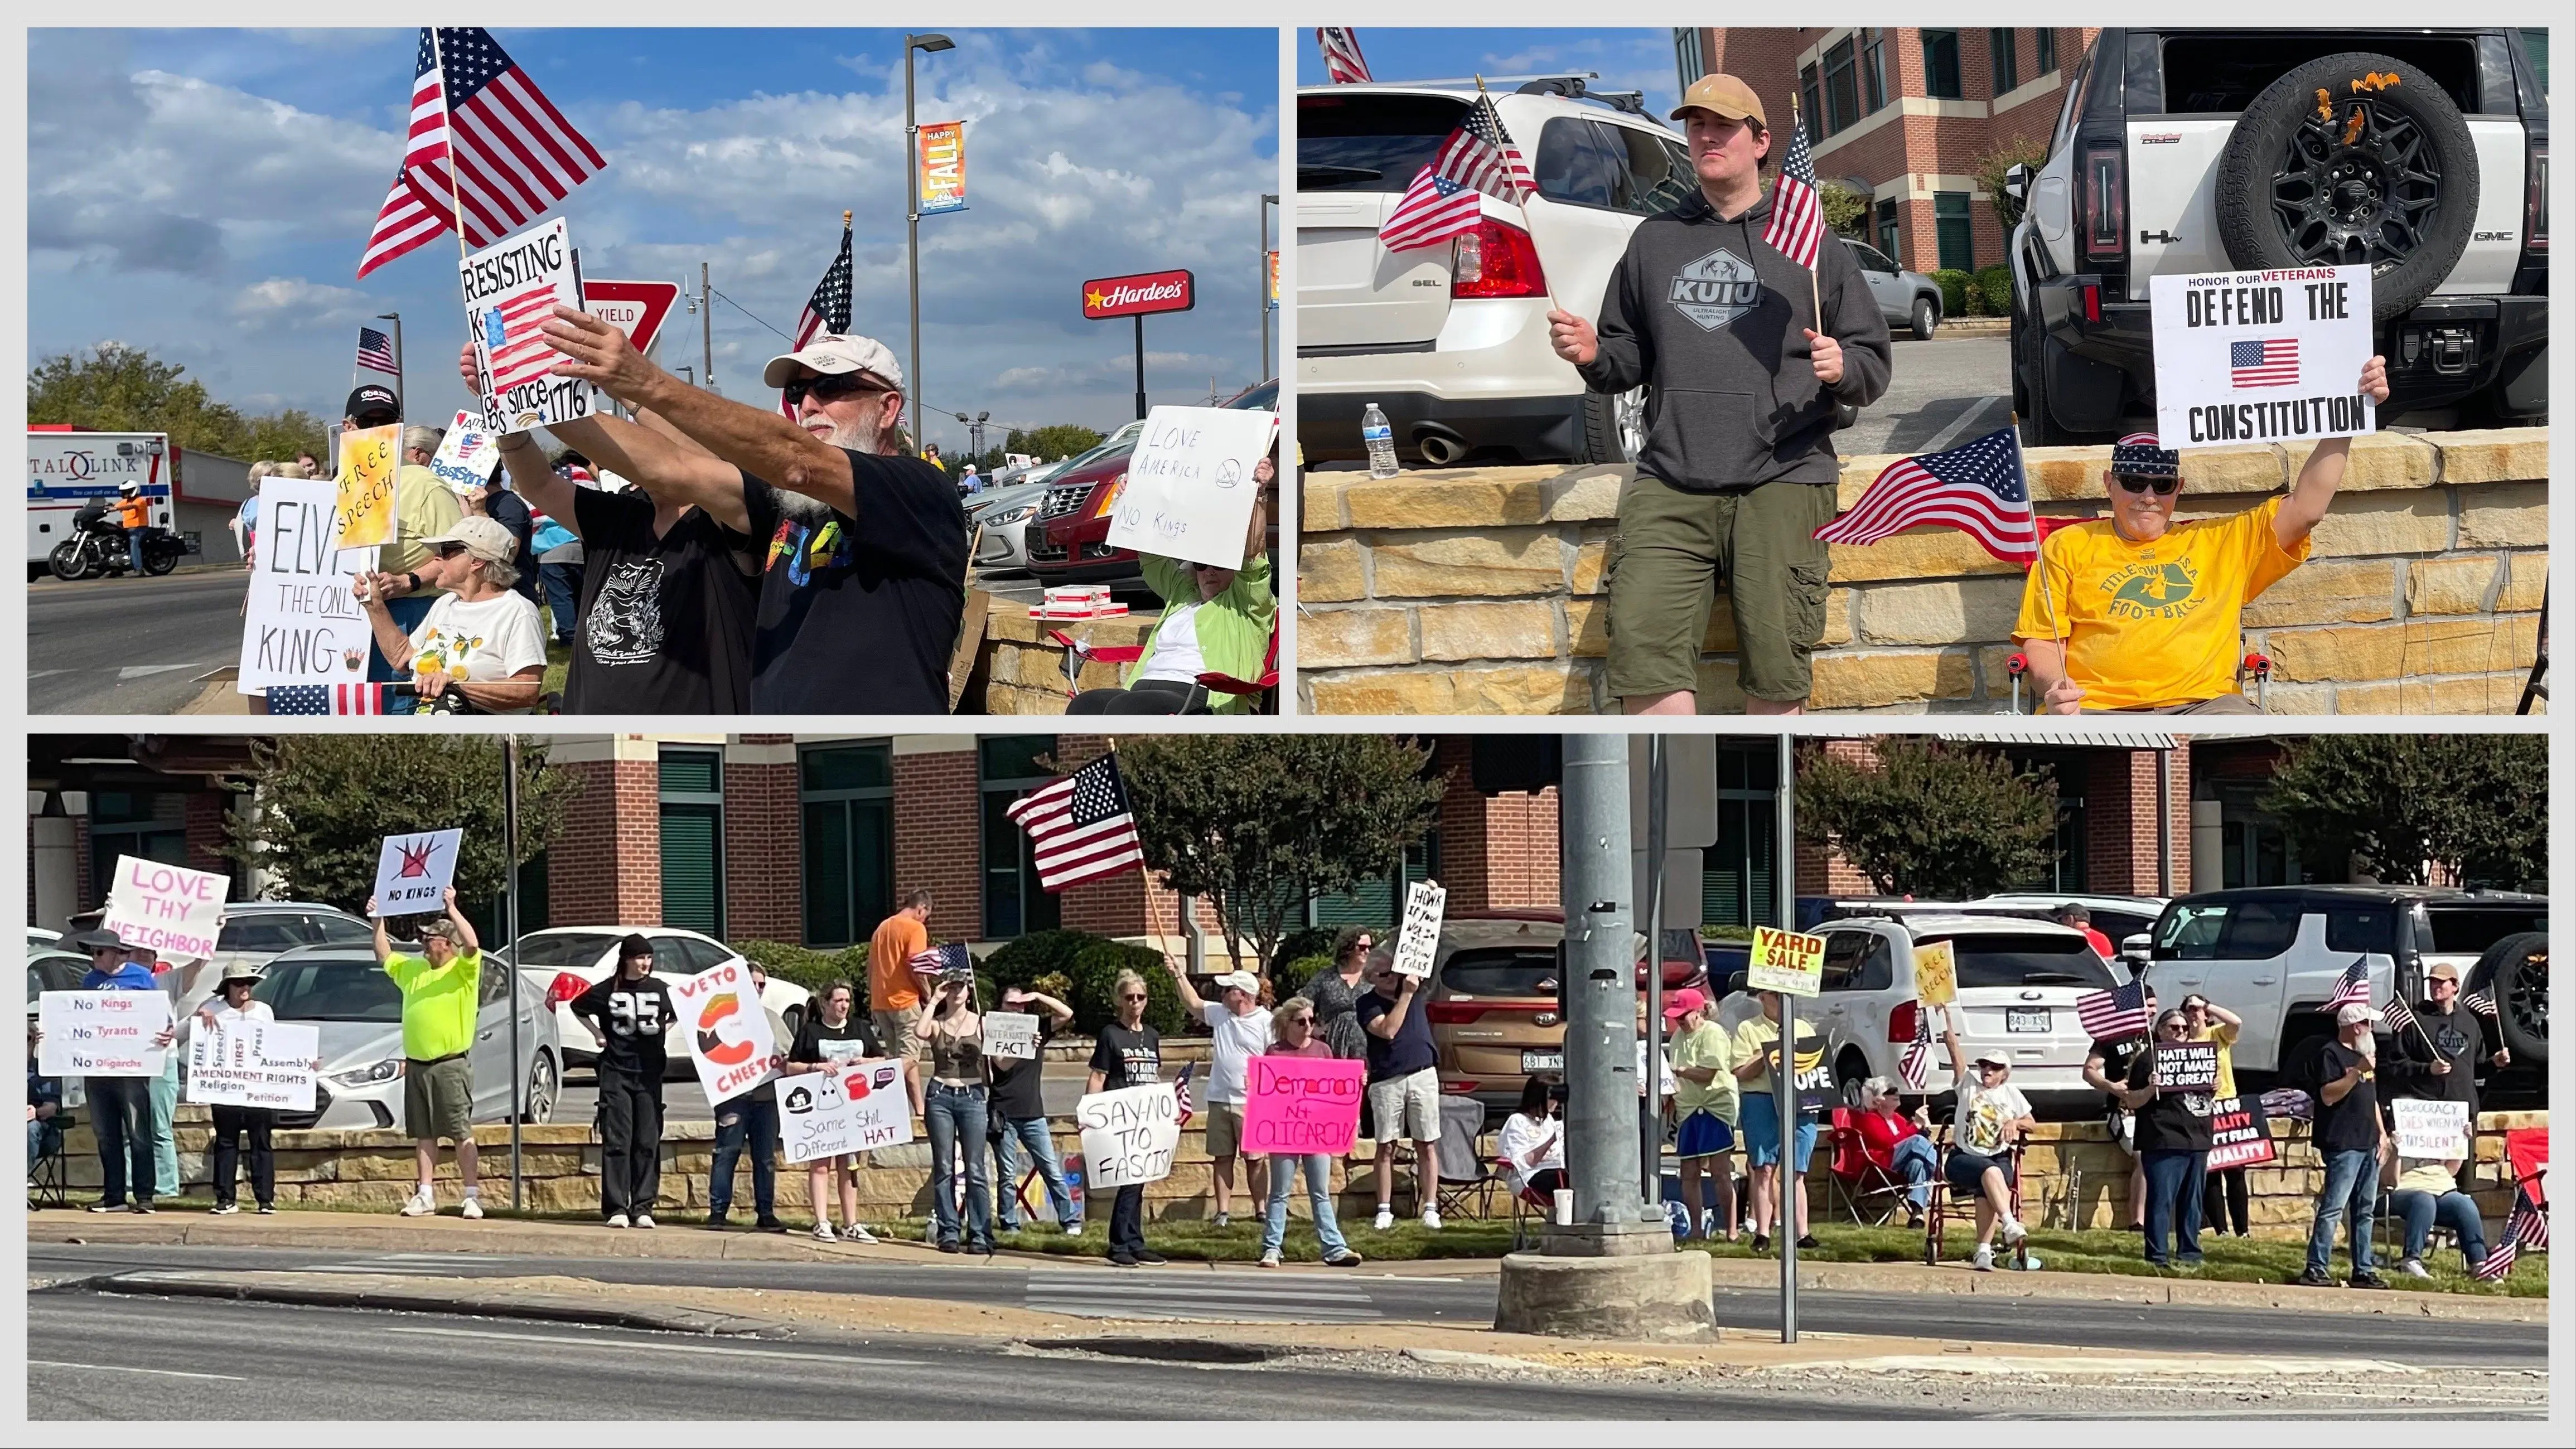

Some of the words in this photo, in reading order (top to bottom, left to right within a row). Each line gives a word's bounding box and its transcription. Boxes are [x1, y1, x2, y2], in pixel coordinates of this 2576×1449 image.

[927, 130, 955, 140] HAPPY
[928, 138, 958, 190] FALL
[2474, 232, 2514, 241] GMC
[461, 234, 562, 303] RESISTING
[2188, 277, 2230, 287] HONOR
[2236, 275, 2260, 284] OUR
[2261, 268, 2336, 282] VETERANS
[1102, 280, 1182, 308] Hardee's
[1673, 279, 1758, 303] KUIU
[596, 308, 634, 322] YIELD
[1693, 307, 1731, 316] ULTRALIGHT
[2186, 287, 2284, 328] DEFEND
[2304, 282, 2349, 321] THE
[508, 379, 549, 415] since
[549, 379, 586, 422] 1776
[2188, 395, 2366, 443] CONSTITUTION
[1149, 420, 1201, 449] LOVE
[90, 458, 137, 473] LINK
[339, 442, 388, 495] FREE
[1137, 455, 1200, 479] AMERICA
[338, 469, 394, 535] SPEECH
[1118, 504, 1140, 526] NO
[1153, 510, 1187, 536] Kings
[278, 584, 316, 614] THE
[2108, 597, 2206, 619] FOOTBALL
[258, 624, 337, 674] KING
[132, 862, 216, 900] LOVE
[388, 889, 402, 902] NO
[406, 885, 436, 900] KINGS
[1414, 888, 1442, 908] HONK
[142, 895, 193, 922] THY
[1760, 928, 1822, 954] YARD
[1766, 948, 1808, 971] SALE
[1915, 949, 1945, 980] FREE
[678, 966, 737, 997] VETO
[74, 999, 93, 1010] No
[100, 998, 133, 1011] Kings
[608, 991, 661, 1036] 95
[73, 1028, 91, 1040] No
[96, 1026, 139, 1038] Tyrants
[252, 1028, 263, 1057] Press
[195, 1041, 205, 1067] FREE
[235, 1037, 244, 1068] FIRST
[995, 1041, 1027, 1055] FACT
[2158, 1048, 2187, 1062] HATE
[2189, 1047, 2216, 1059] WILL
[73, 1057, 92, 1068] No
[95, 1058, 142, 1070] Oligarchs
[716, 1054, 781, 1093] CHEETO
[2158, 1062, 2183, 1074] NOT
[2184, 1059, 2216, 1072] MAKE
[192, 1069, 264, 1082] AMENDMENT
[266, 1073, 307, 1084] RIGHTS
[199, 1080, 245, 1092] Religion
[2176, 1072, 2216, 1085] GREAT
[247, 1092, 288, 1103] Petition
[2224, 1098, 2241, 1113] OF
[2399, 1102, 2458, 1115] DEMOCRACY
[803, 1117, 847, 1140] Same
[2213, 1112, 2250, 1130] ALITY
[795, 1137, 848, 1160] Different
[864, 1127, 896, 1145] HAT
[1114, 1127, 1152, 1157] TO
[2229, 1126, 2259, 1142] FEAR
[2419, 1135, 2458, 1148] SILENT
[1098, 1148, 1173, 1184] FASCIS
[2207, 1141, 2265, 1167] UALITY
